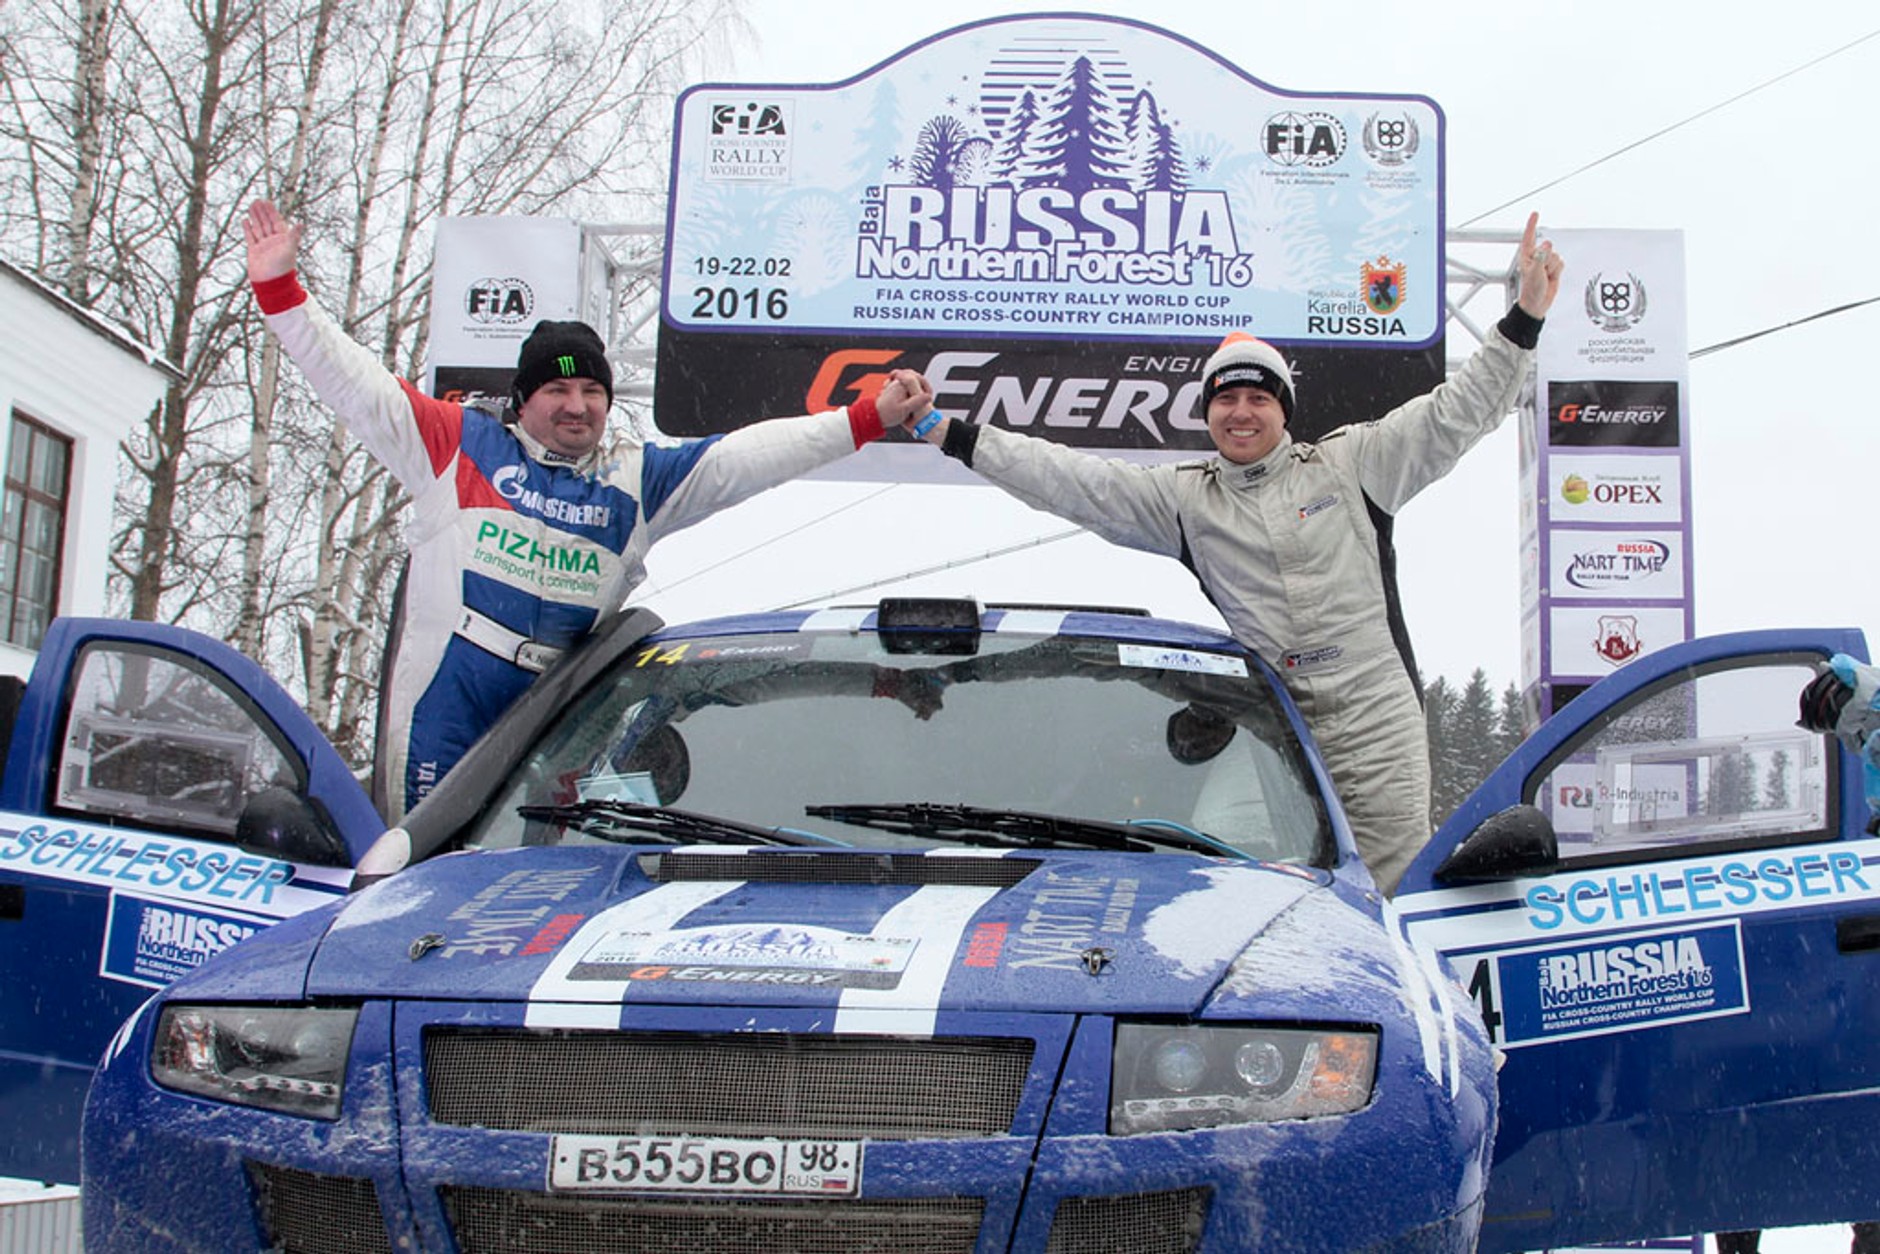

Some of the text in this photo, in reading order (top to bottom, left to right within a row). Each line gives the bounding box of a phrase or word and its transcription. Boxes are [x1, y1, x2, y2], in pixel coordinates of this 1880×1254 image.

[712, 149, 785, 163] RALLY
[709, 165, 787, 177] WORLD CUP
[859, 186, 880, 233] Baja
[884, 185, 1240, 256] RUSSIA
[694, 257, 791, 277] 19-22.02
[857, 236, 1050, 281] Northern
[1053, 240, 1193, 285] Forest
[691, 287, 789, 319] 2016
[876, 289, 1231, 308] FIA CROSS-COUNTRY RALLY WORLD CUP
[1308, 300, 1367, 315] Karelia
[853, 306, 1253, 327] RUSSIAN CROSS-COUNTRY CHAMPIONSHIP
[1308, 316, 1406, 336] RUSSIA
[1124, 356, 1202, 372] ENGI
[477, 520, 600, 575] PIZHMA
[1617, 544, 1655, 553] RUSSIA
[474, 547, 535, 581] transport
[1574, 554, 1662, 572] NART TIME
[635, 643, 691, 668] 14
[0, 825, 296, 904] SCHLESSER
[1526, 852, 1870, 930] SCHLESSER
[138, 934, 206, 966] Northern
[1549, 938, 1707, 990] RUSSIA
[1540, 981, 1626, 1009] Northern
[1627, 970, 1686, 997] Forest
[1542, 989, 1715, 1021] FIA CROSS-COUNTRY RALLY WORLD CUP
[1542, 999, 1715, 1031] RUSSIAN CROSS-COUNTRY CHAMPIONSHIP
[799, 1144, 840, 1171] 98
[785, 1175, 820, 1188] RUS
